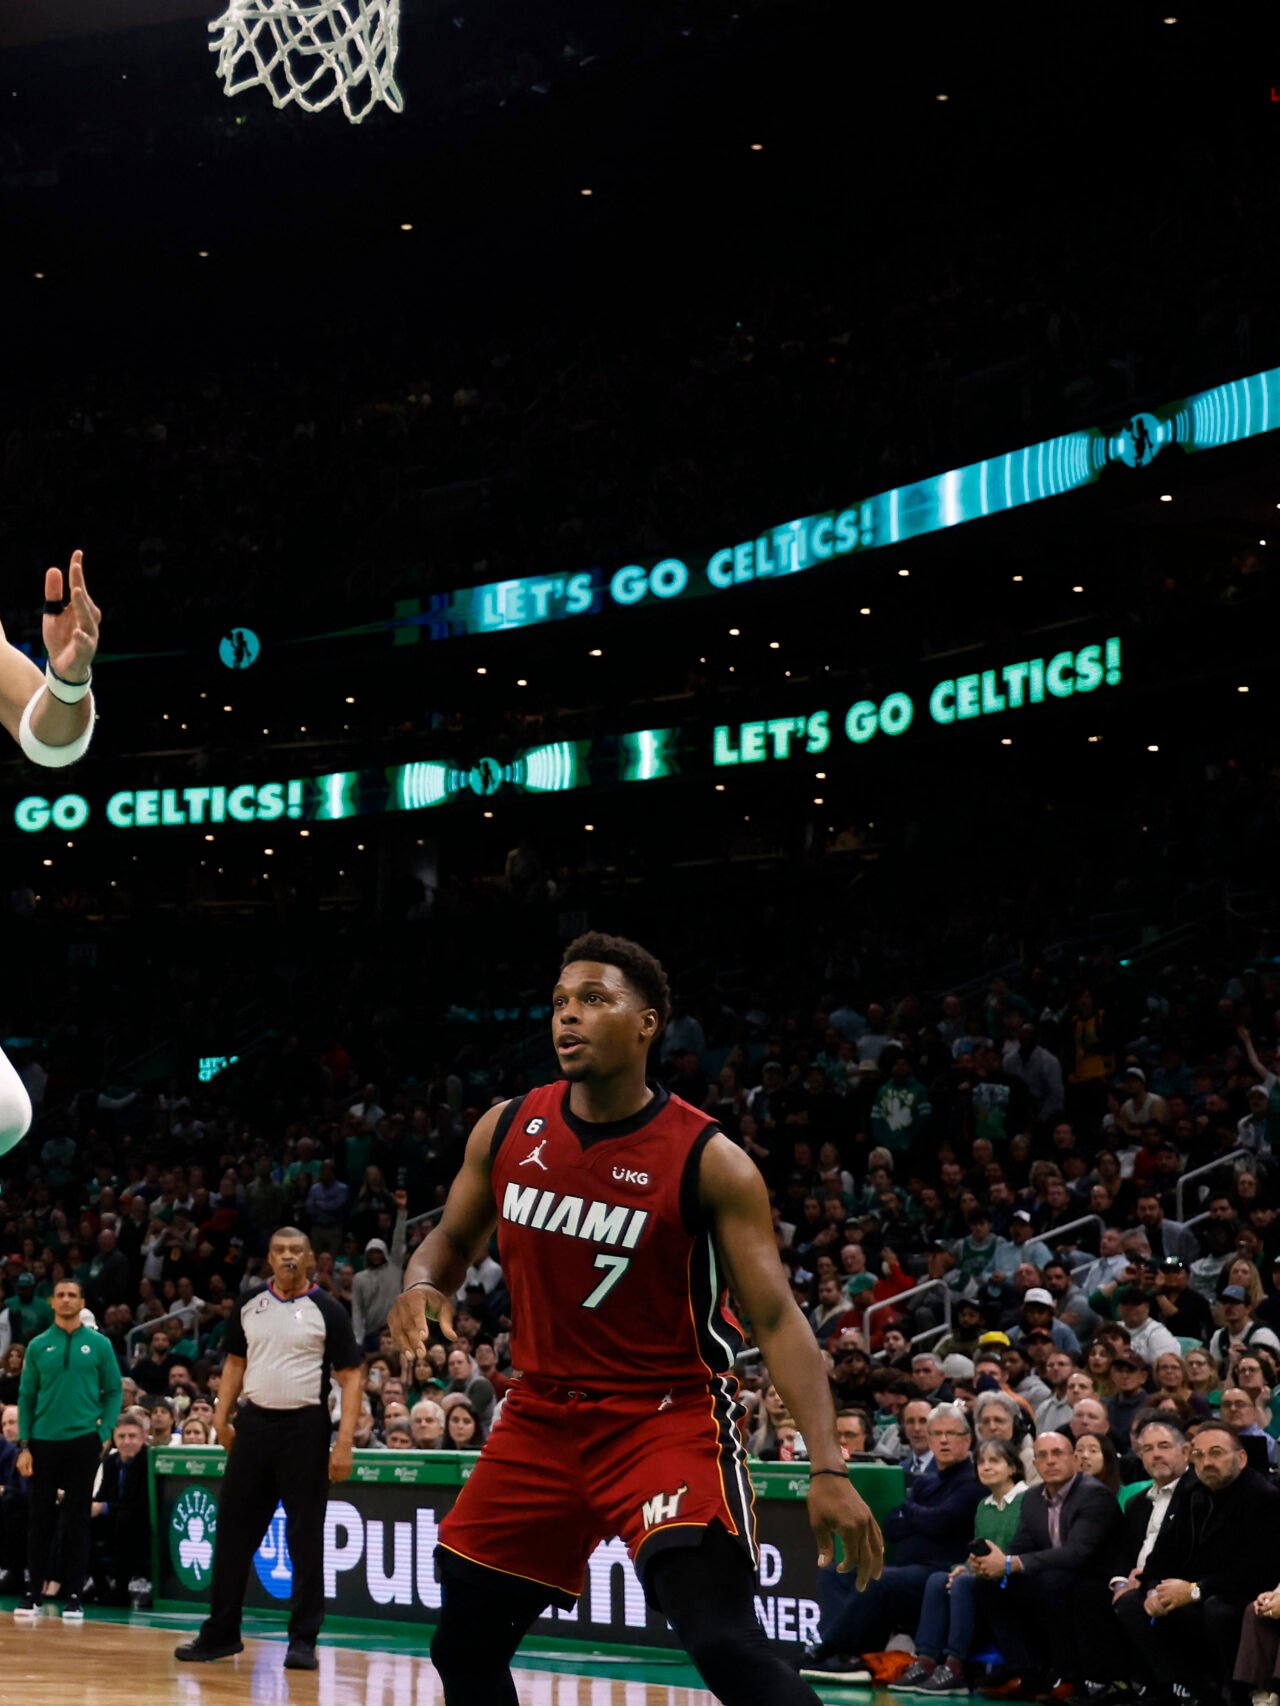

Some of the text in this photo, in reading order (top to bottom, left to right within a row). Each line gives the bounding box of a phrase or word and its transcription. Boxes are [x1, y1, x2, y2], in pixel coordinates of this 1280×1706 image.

[481, 502, 874, 626] LET'S GO CELTICS!
[713, 636, 1122, 766] LET'S GO CELTICS!
[14, 795, 90, 833] GO
[106, 778, 304, 828] CELTICS!
[525, 1118, 543, 1135] 6
[502, 1181, 649, 1250] MIAMI
[581, 1253, 631, 1309] 7
